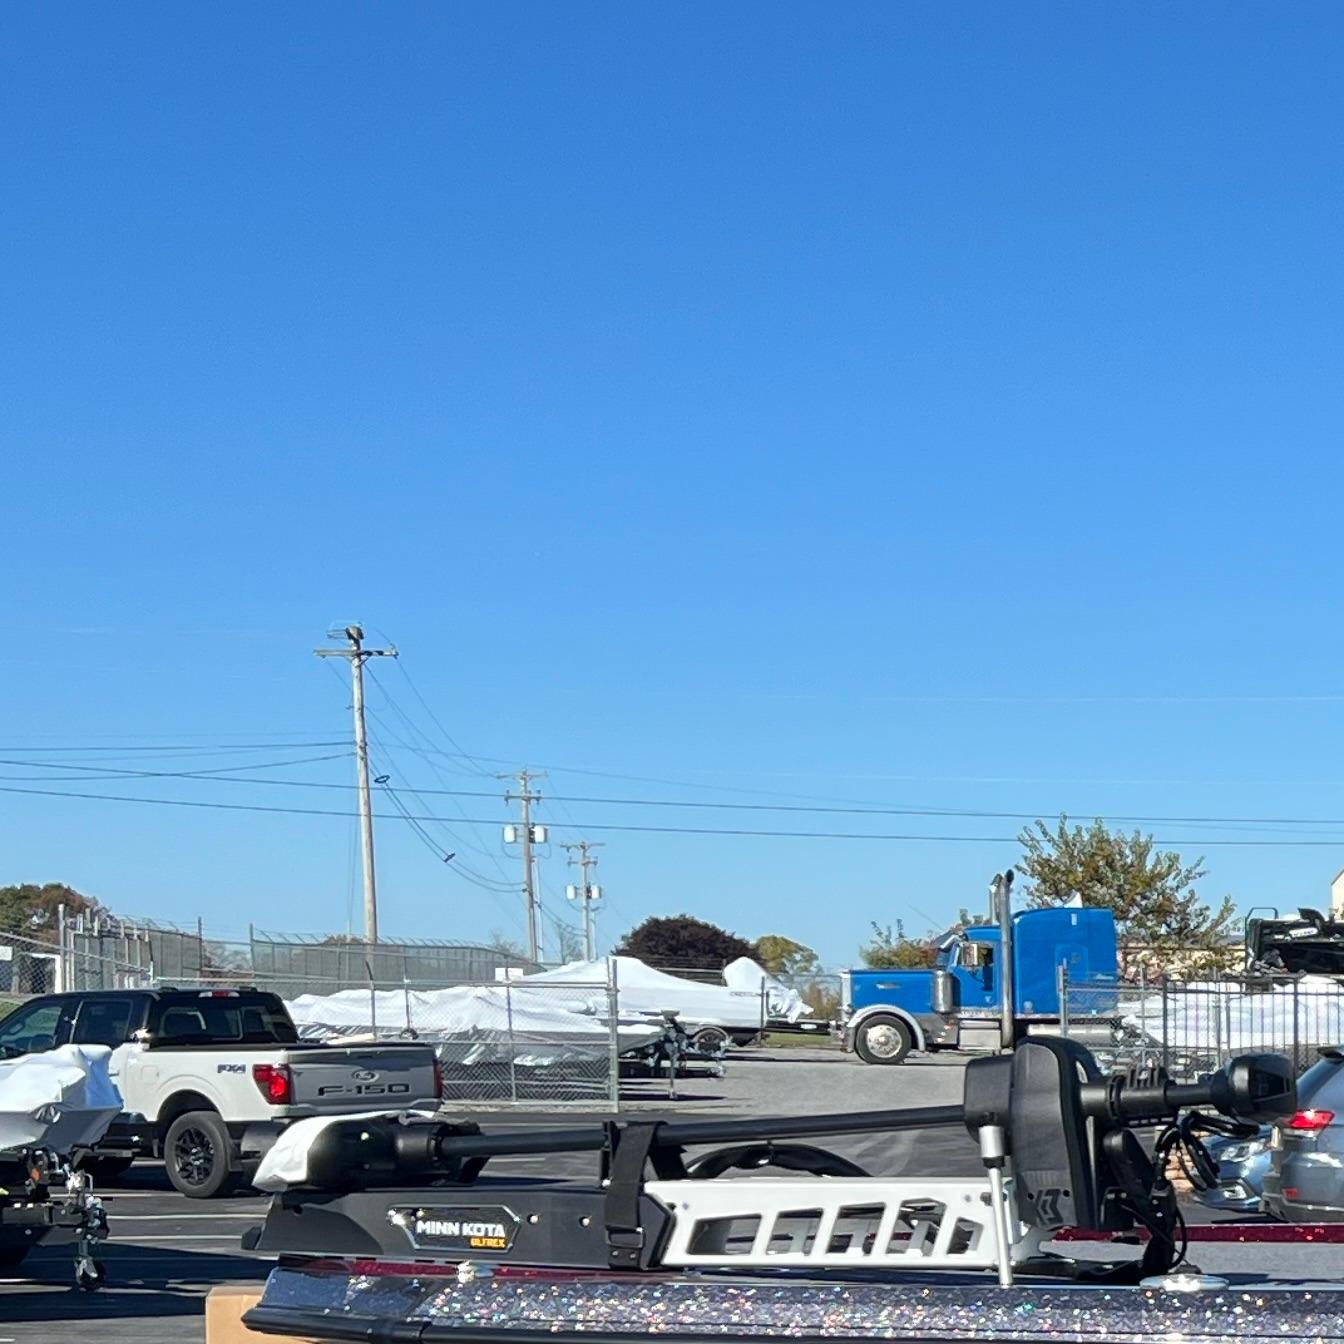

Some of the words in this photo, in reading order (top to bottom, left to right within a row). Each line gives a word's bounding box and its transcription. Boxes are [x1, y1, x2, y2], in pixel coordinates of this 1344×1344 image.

[317, 1082, 410, 1096] F-150
[416, 1220, 460, 1236] MINN
[462, 1222, 506, 1238] KOTA
